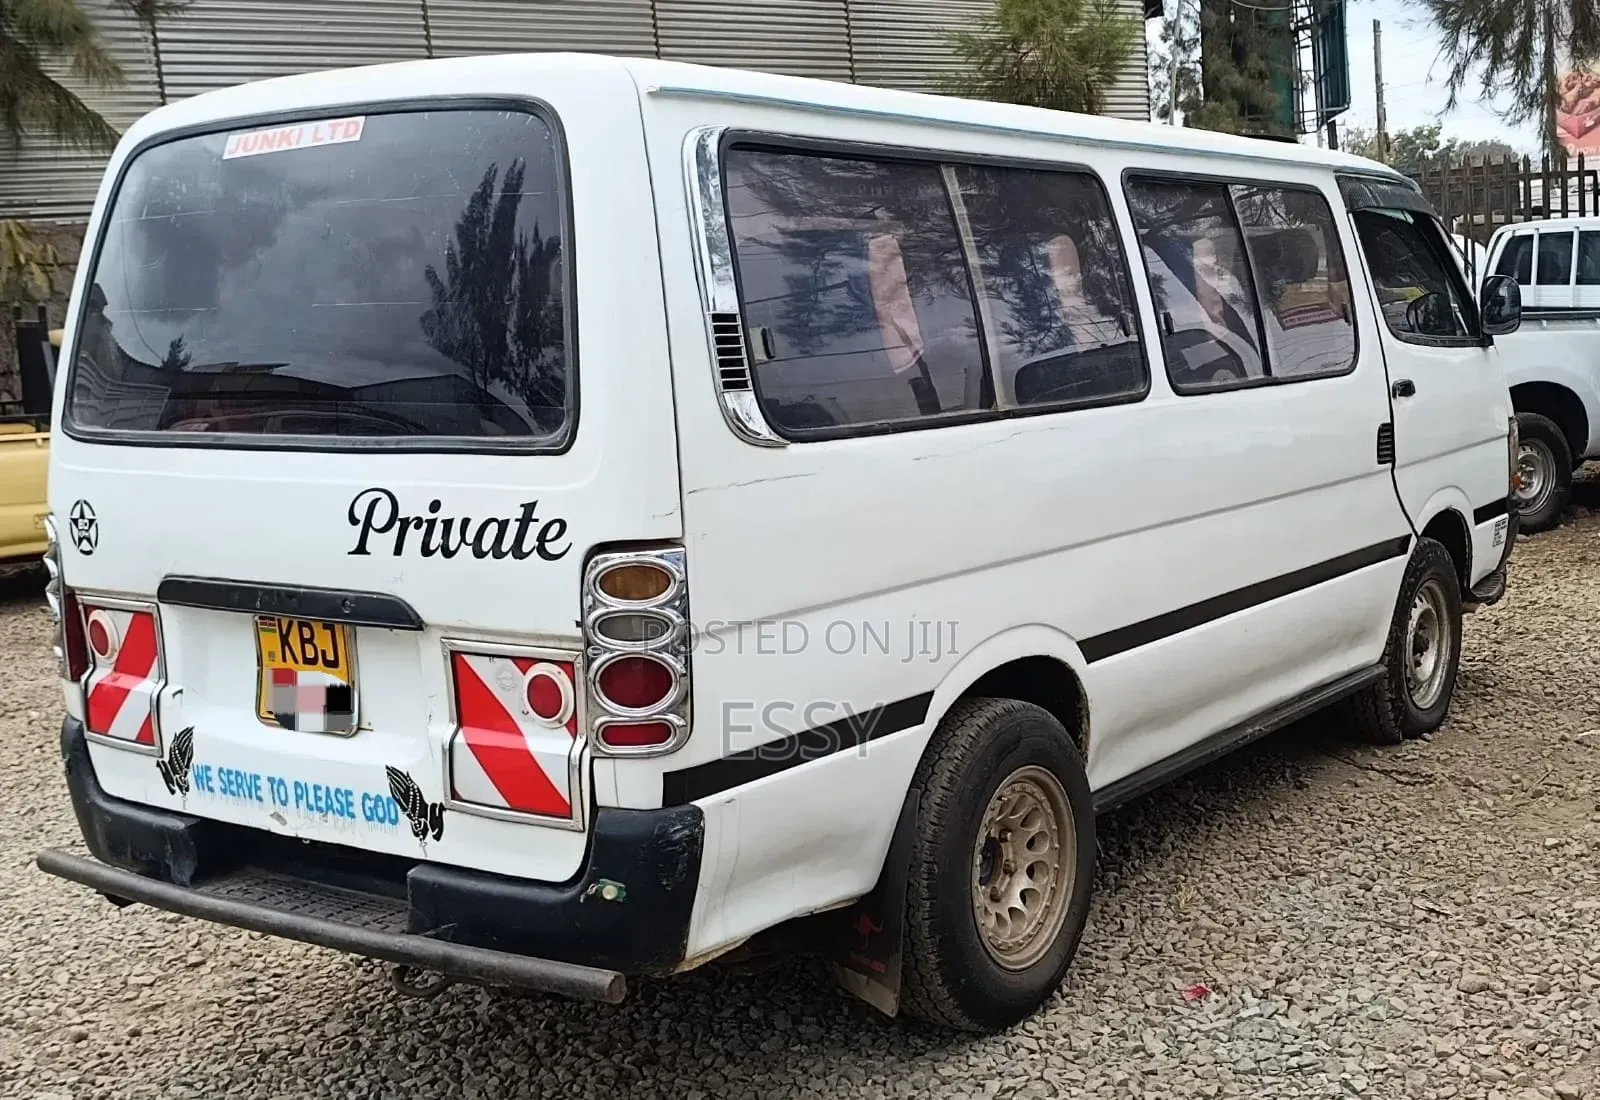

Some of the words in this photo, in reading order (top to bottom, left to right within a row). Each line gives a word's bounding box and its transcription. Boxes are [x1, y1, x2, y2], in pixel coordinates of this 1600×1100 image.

[227, 127, 303, 155] JUNKI
[312, 120, 359, 143] LTD
[347, 487, 572, 561] Private
[277, 617, 340, 669] KBJ
[192, 763, 214, 793] WE
[218, 767, 263, 802] SERVE
[267, 776, 288, 806] TO
[294, 781, 356, 819] PLEASE
[362, 793, 399, 826] GOD
